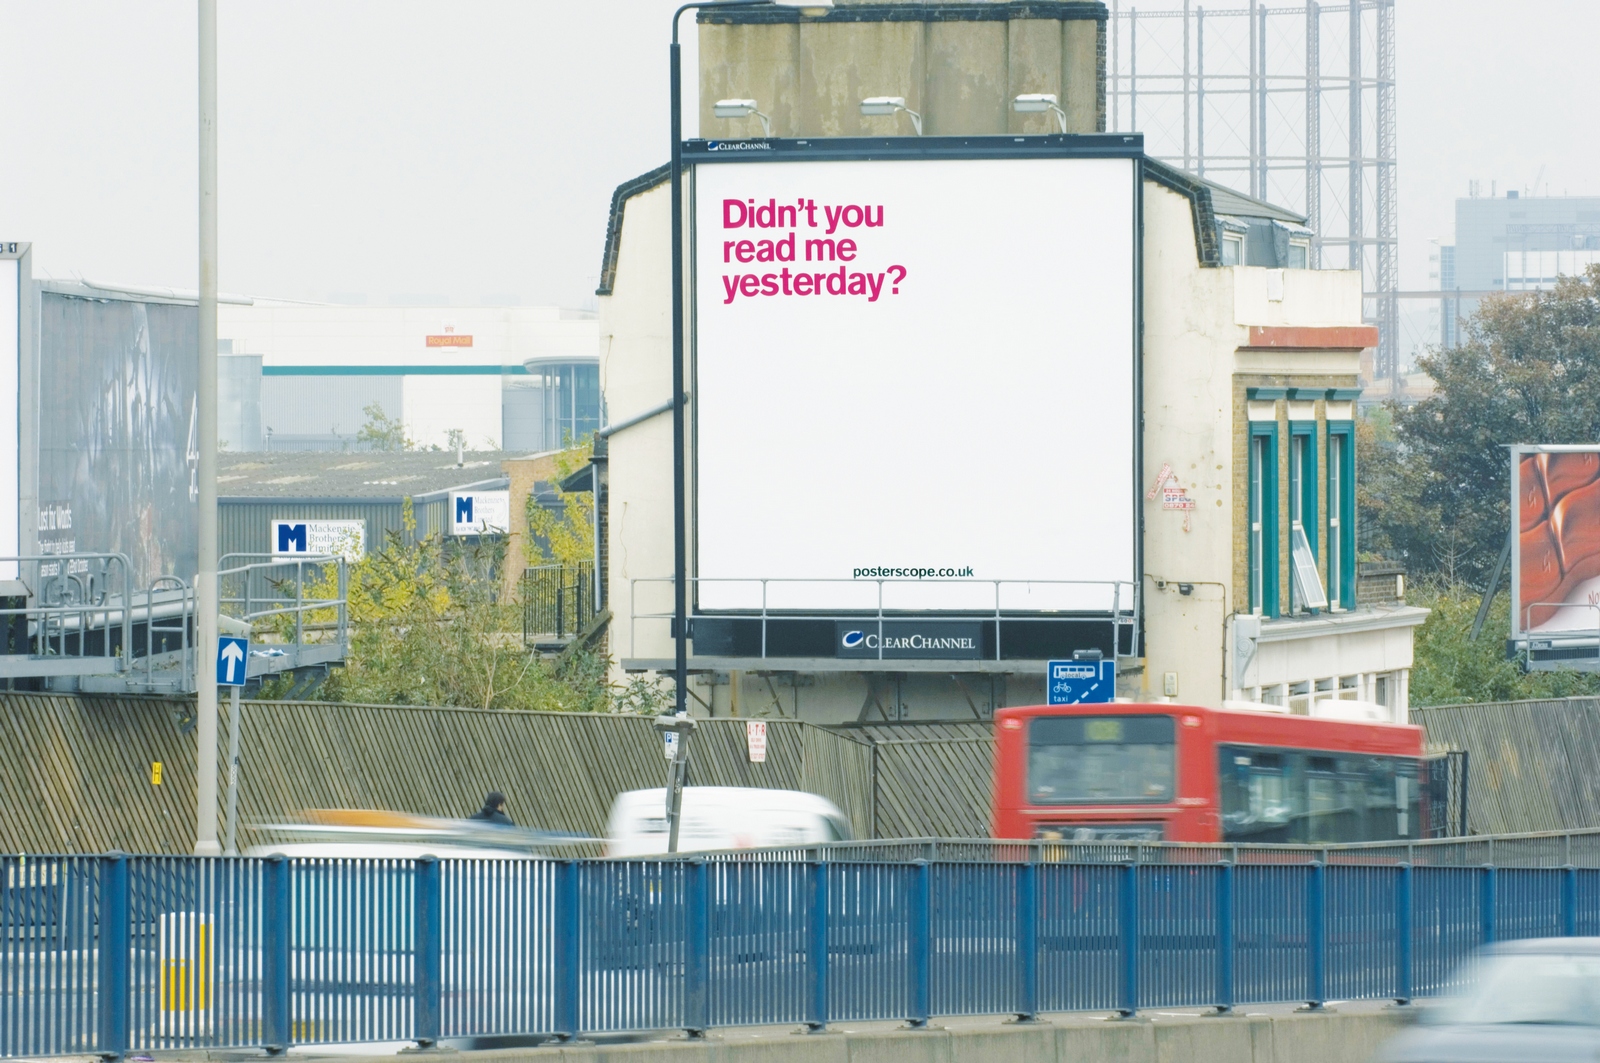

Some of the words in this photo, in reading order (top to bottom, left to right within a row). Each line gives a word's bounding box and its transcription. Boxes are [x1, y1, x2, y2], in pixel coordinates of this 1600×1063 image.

[824, 204, 884, 234] you
[723, 232, 796, 263] read
[805, 238, 857, 262] me
[722, 265, 907, 305] yesterday?
[428, 336, 452, 345] Royal
[278, 524, 306, 551] M
[853, 566, 974, 579] posterscope.co.uk
[1053, 695, 1069, 703] taxi
